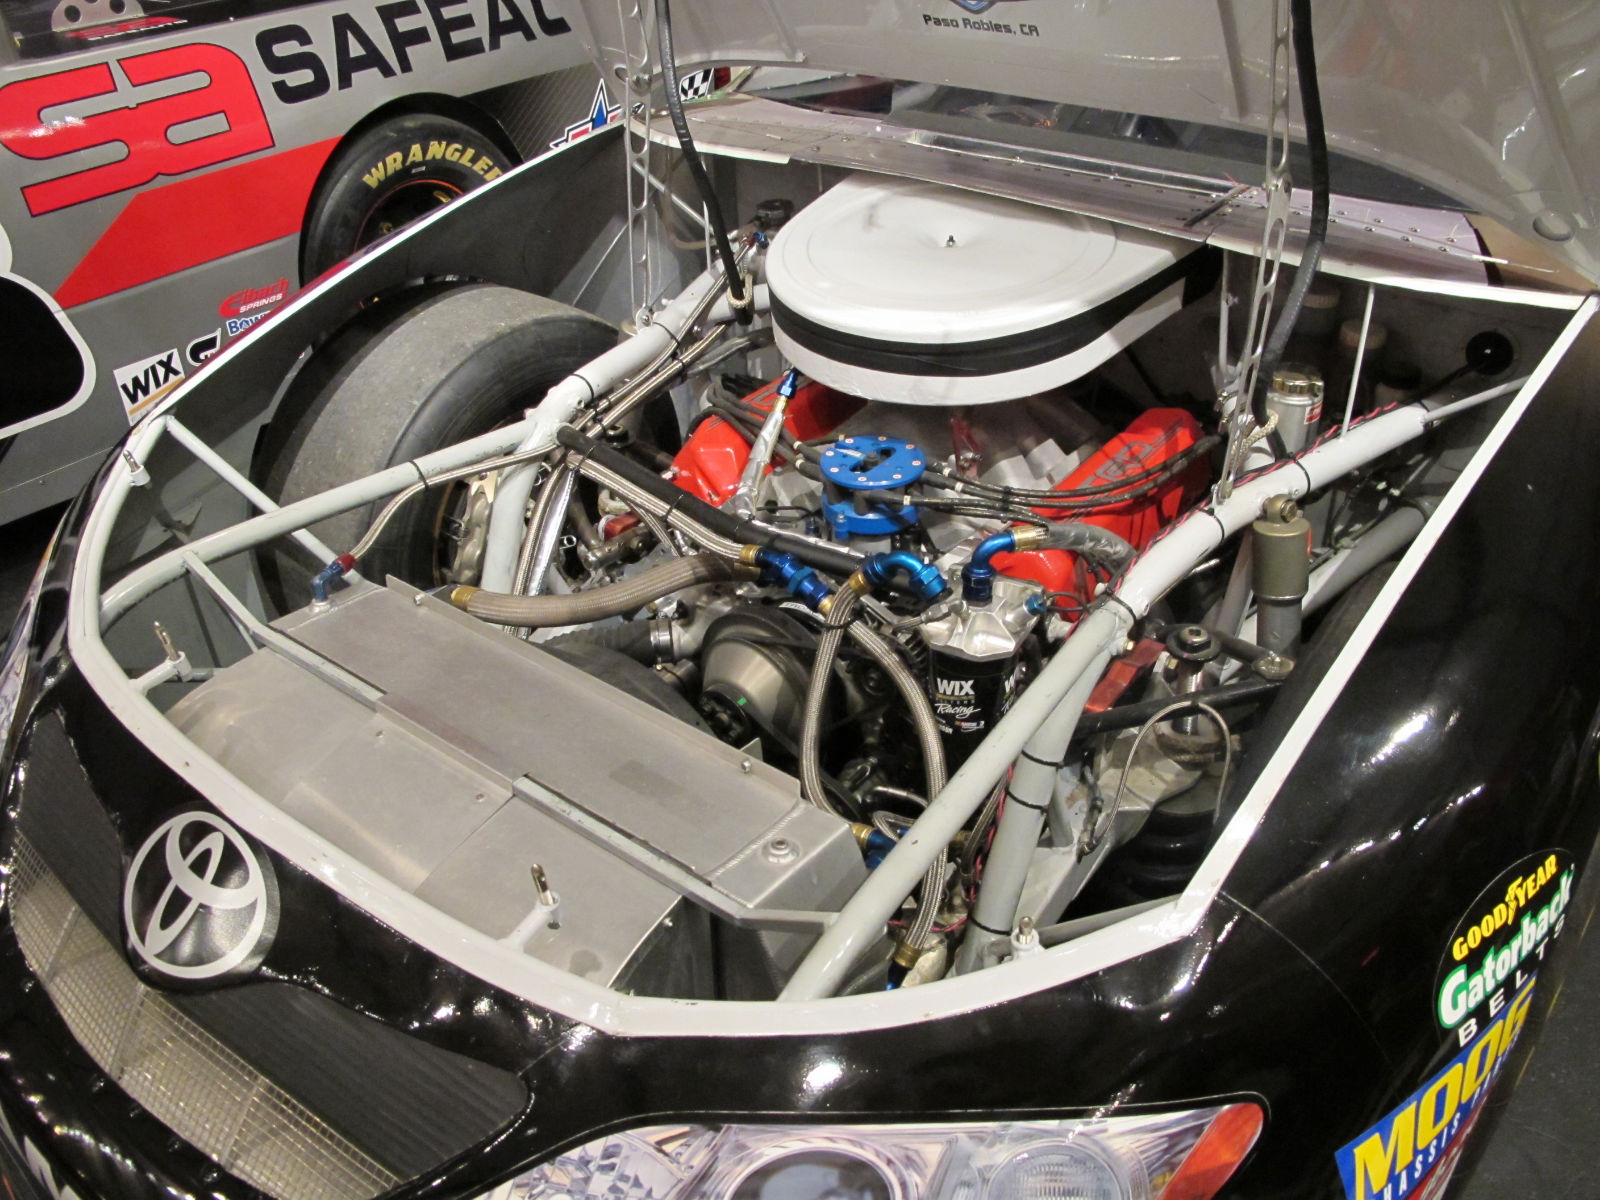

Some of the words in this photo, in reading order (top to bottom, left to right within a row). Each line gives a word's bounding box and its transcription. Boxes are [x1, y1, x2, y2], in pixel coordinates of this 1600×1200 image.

[923, 14, 959, 28] Paso
[962, 17, 1017, 35] Robles,
[1020, 23, 1040, 37] CA
[240, 293, 283, 313] SPRINGS
[121, 352, 181, 405] WIX
[936, 677, 976, 696] WIX
[934, 703, 982, 719] Racing
[1439, 869, 1574, 1029] Gatorback
[1383, 1112, 1461, 1200] HASSIS
